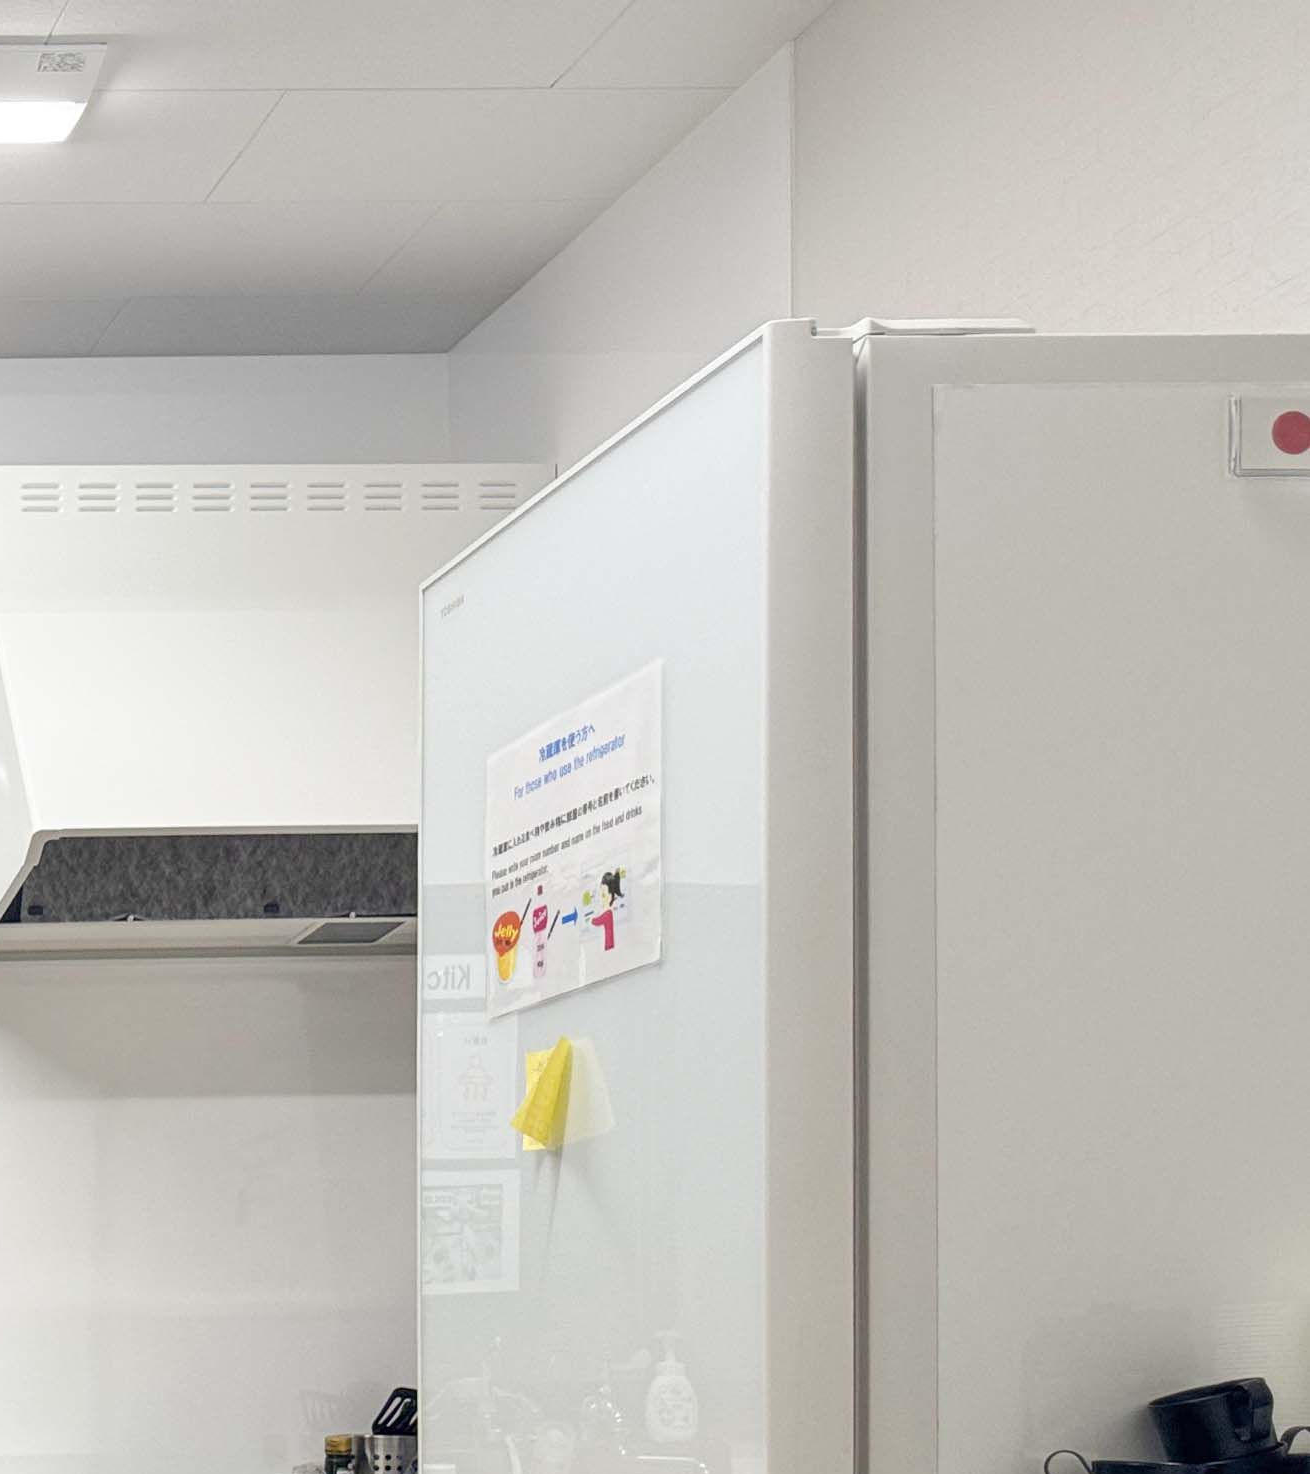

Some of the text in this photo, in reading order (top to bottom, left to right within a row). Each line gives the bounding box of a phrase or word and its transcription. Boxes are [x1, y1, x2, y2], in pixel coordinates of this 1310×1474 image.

[514, 734, 626, 801] For those who use the refrigerator
[494, 923, 519, 942] Jelly
